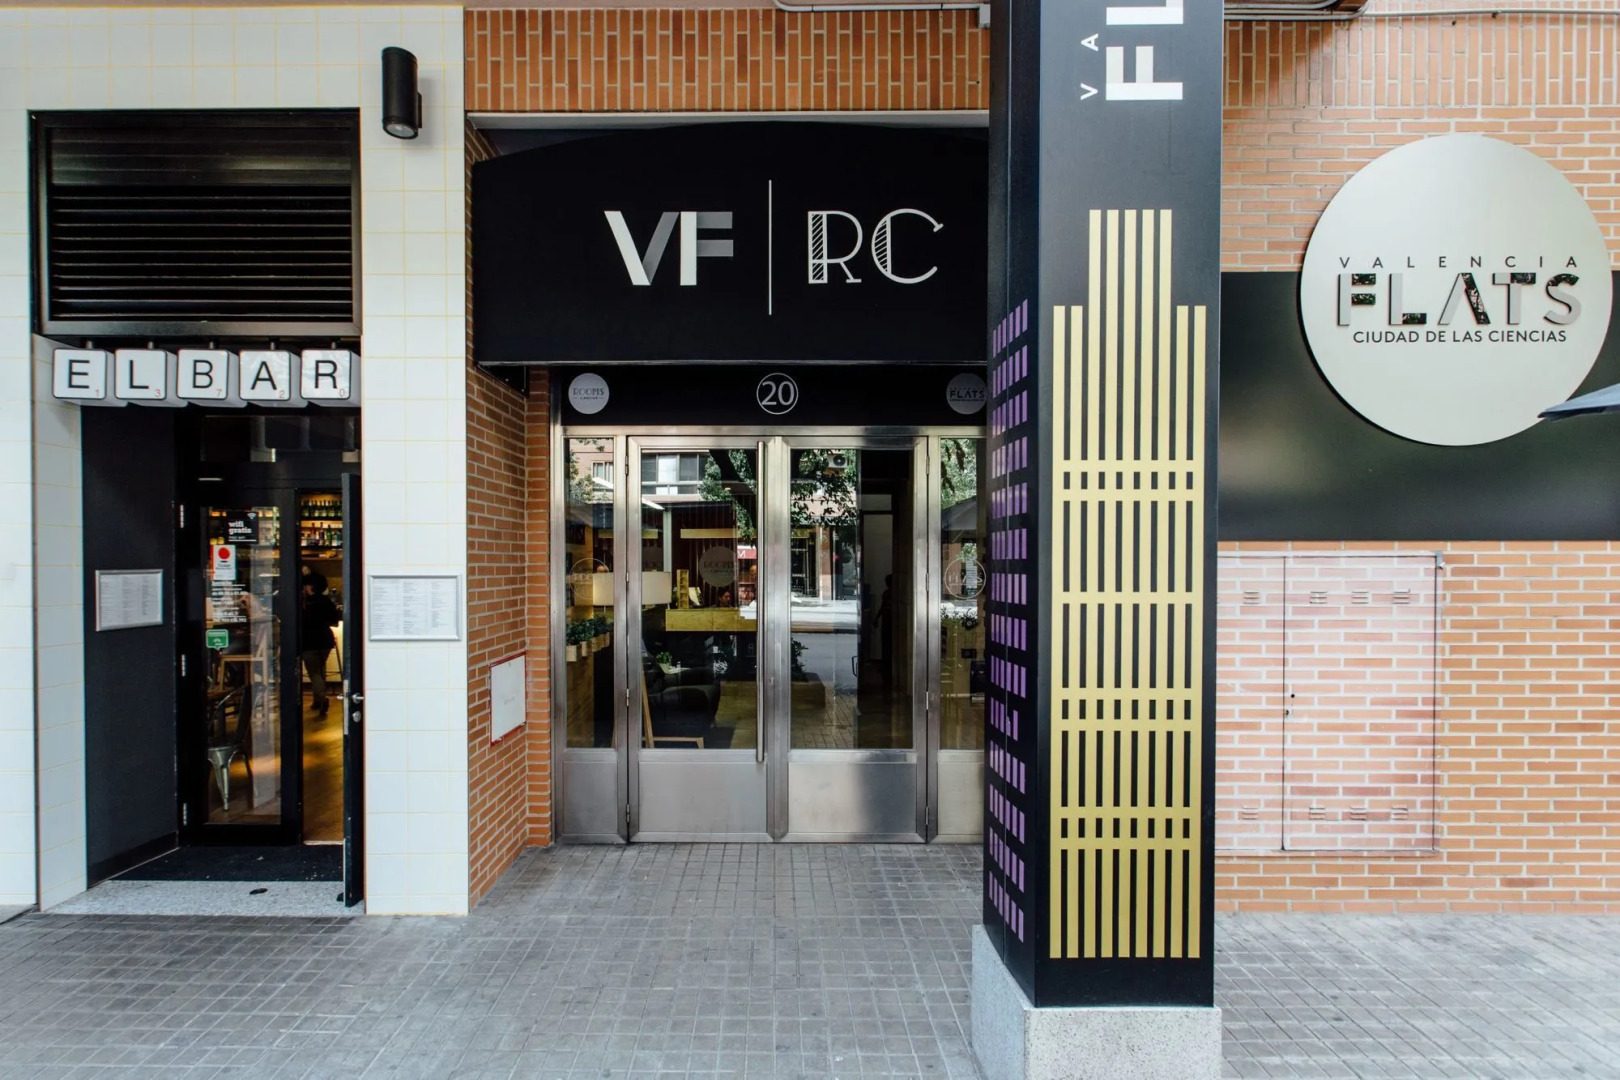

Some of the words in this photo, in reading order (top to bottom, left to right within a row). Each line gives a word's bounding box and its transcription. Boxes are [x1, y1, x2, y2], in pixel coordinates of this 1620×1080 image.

[604, 210, 734, 286] VF
[808, 208, 944, 285] RC
[1339, 256, 1578, 269] VALENCIA
[1336, 272, 1582, 326] FLATS
[1353, 330, 1420, 344] CIUDAD
[1425, 330, 1447, 343] DE
[1452, 330, 1483, 343] LAS
[1488, 330, 1567, 343] CIENCIAS
[572, 387, 605, 396] ROOMS
[761, 380, 794, 406] 20
[949, 390, 985, 399] FLATS
[228, 520, 244, 528] wifi
[228, 526, 252, 535] gratis
